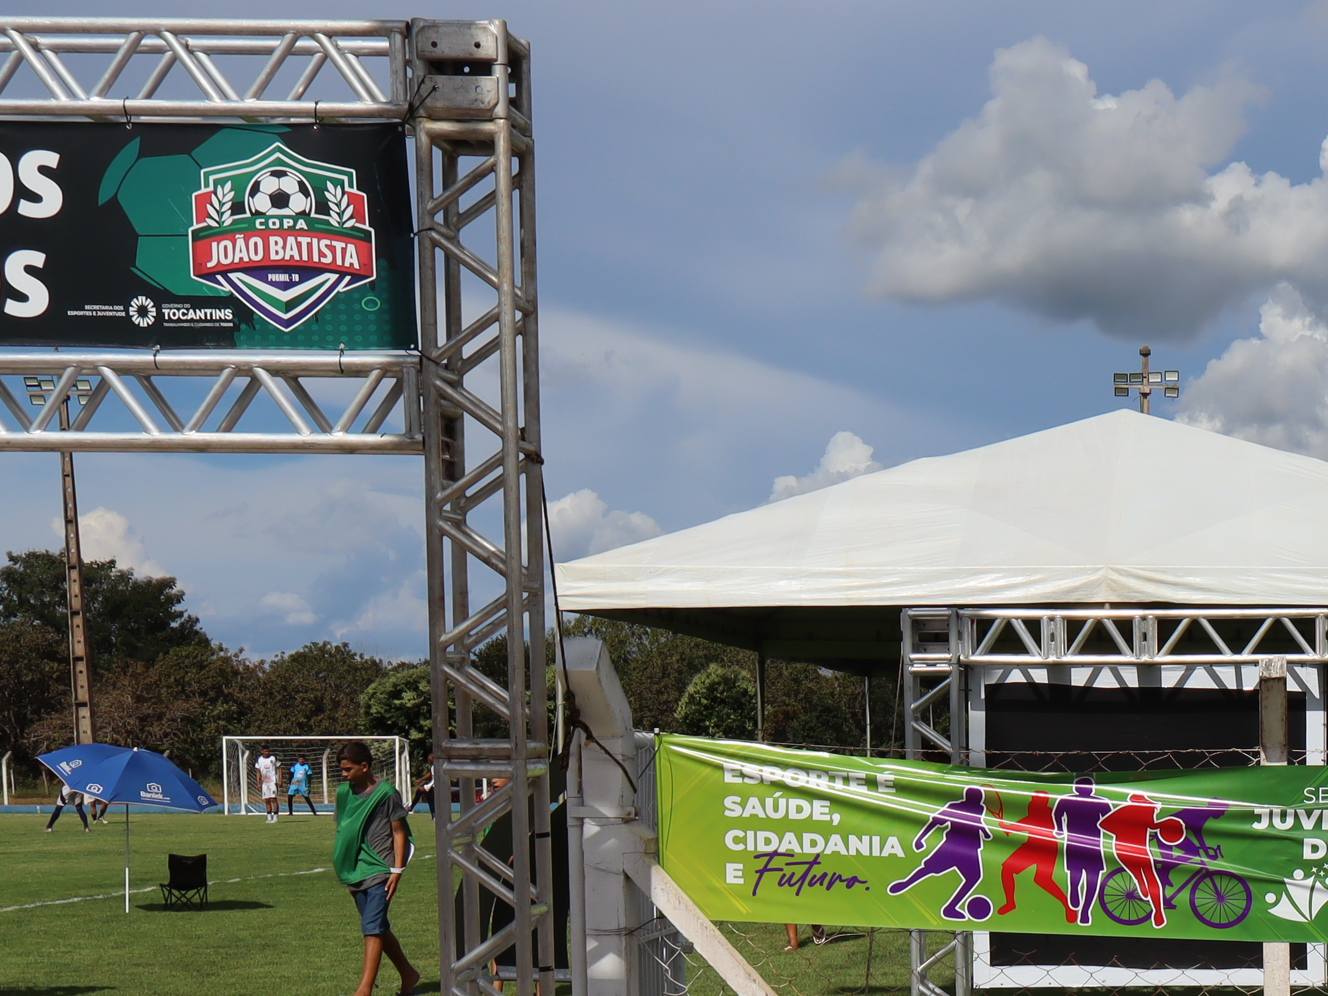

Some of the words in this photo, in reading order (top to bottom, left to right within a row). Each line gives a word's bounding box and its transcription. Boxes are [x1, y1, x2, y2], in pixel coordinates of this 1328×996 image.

[0, 149, 64, 219] S
[255, 218, 308, 230] COPA
[206, 234, 264, 268] JOÃO
[268, 235, 360, 269] BATISTA
[161, 308, 233, 320] TOCANTINS
[723, 763, 868, 792] ESPORTE
[723, 791, 842, 826] SAÚDE,
[724, 829, 906, 858] CIDADANIA
[725, 863, 745, 884] E
[752, 850, 870, 897] Futuro.
